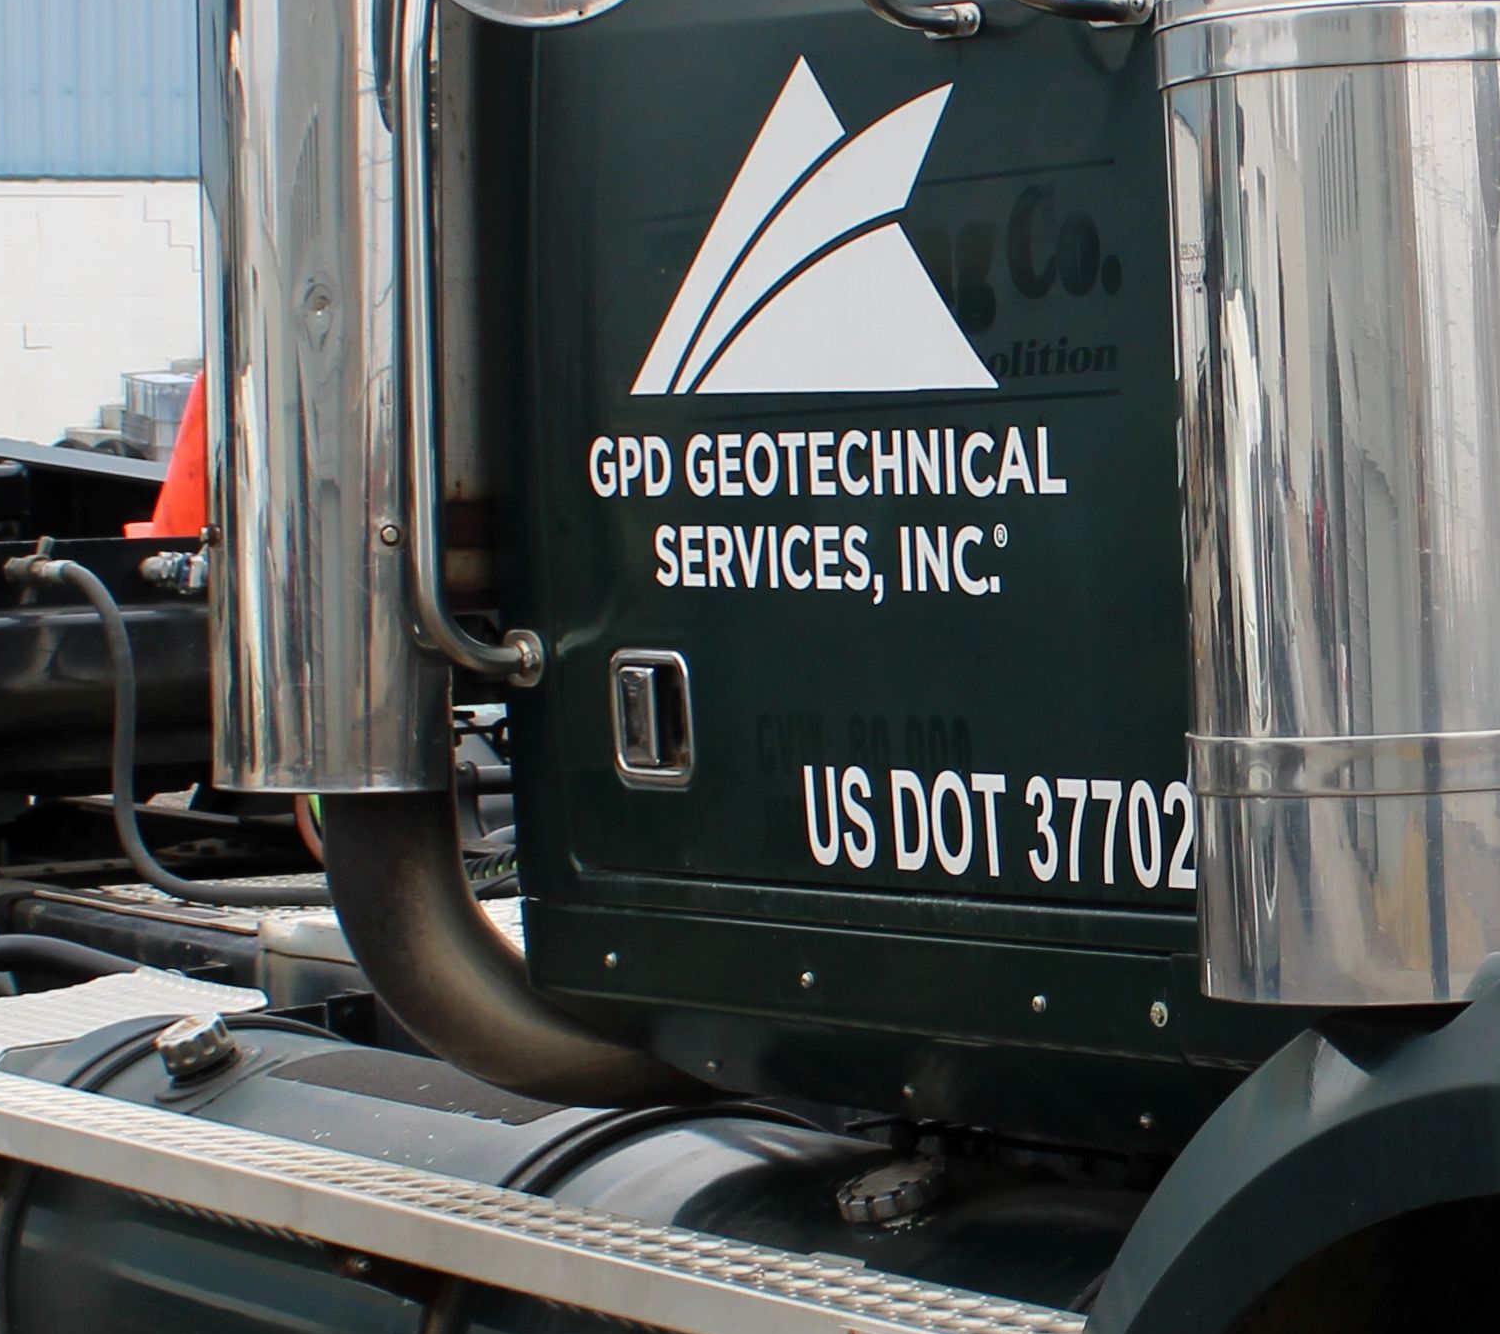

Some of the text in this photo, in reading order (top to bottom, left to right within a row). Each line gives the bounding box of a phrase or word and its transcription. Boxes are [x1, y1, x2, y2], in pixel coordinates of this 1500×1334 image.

[989, 335, 1120, 379] olition
[589, 426, 1067, 498] GPD GEOTECHNICAL
[655, 524, 884, 605] SERVICES,
[803, 765, 876, 869] US
[890, 769, 1007, 877] DOT
